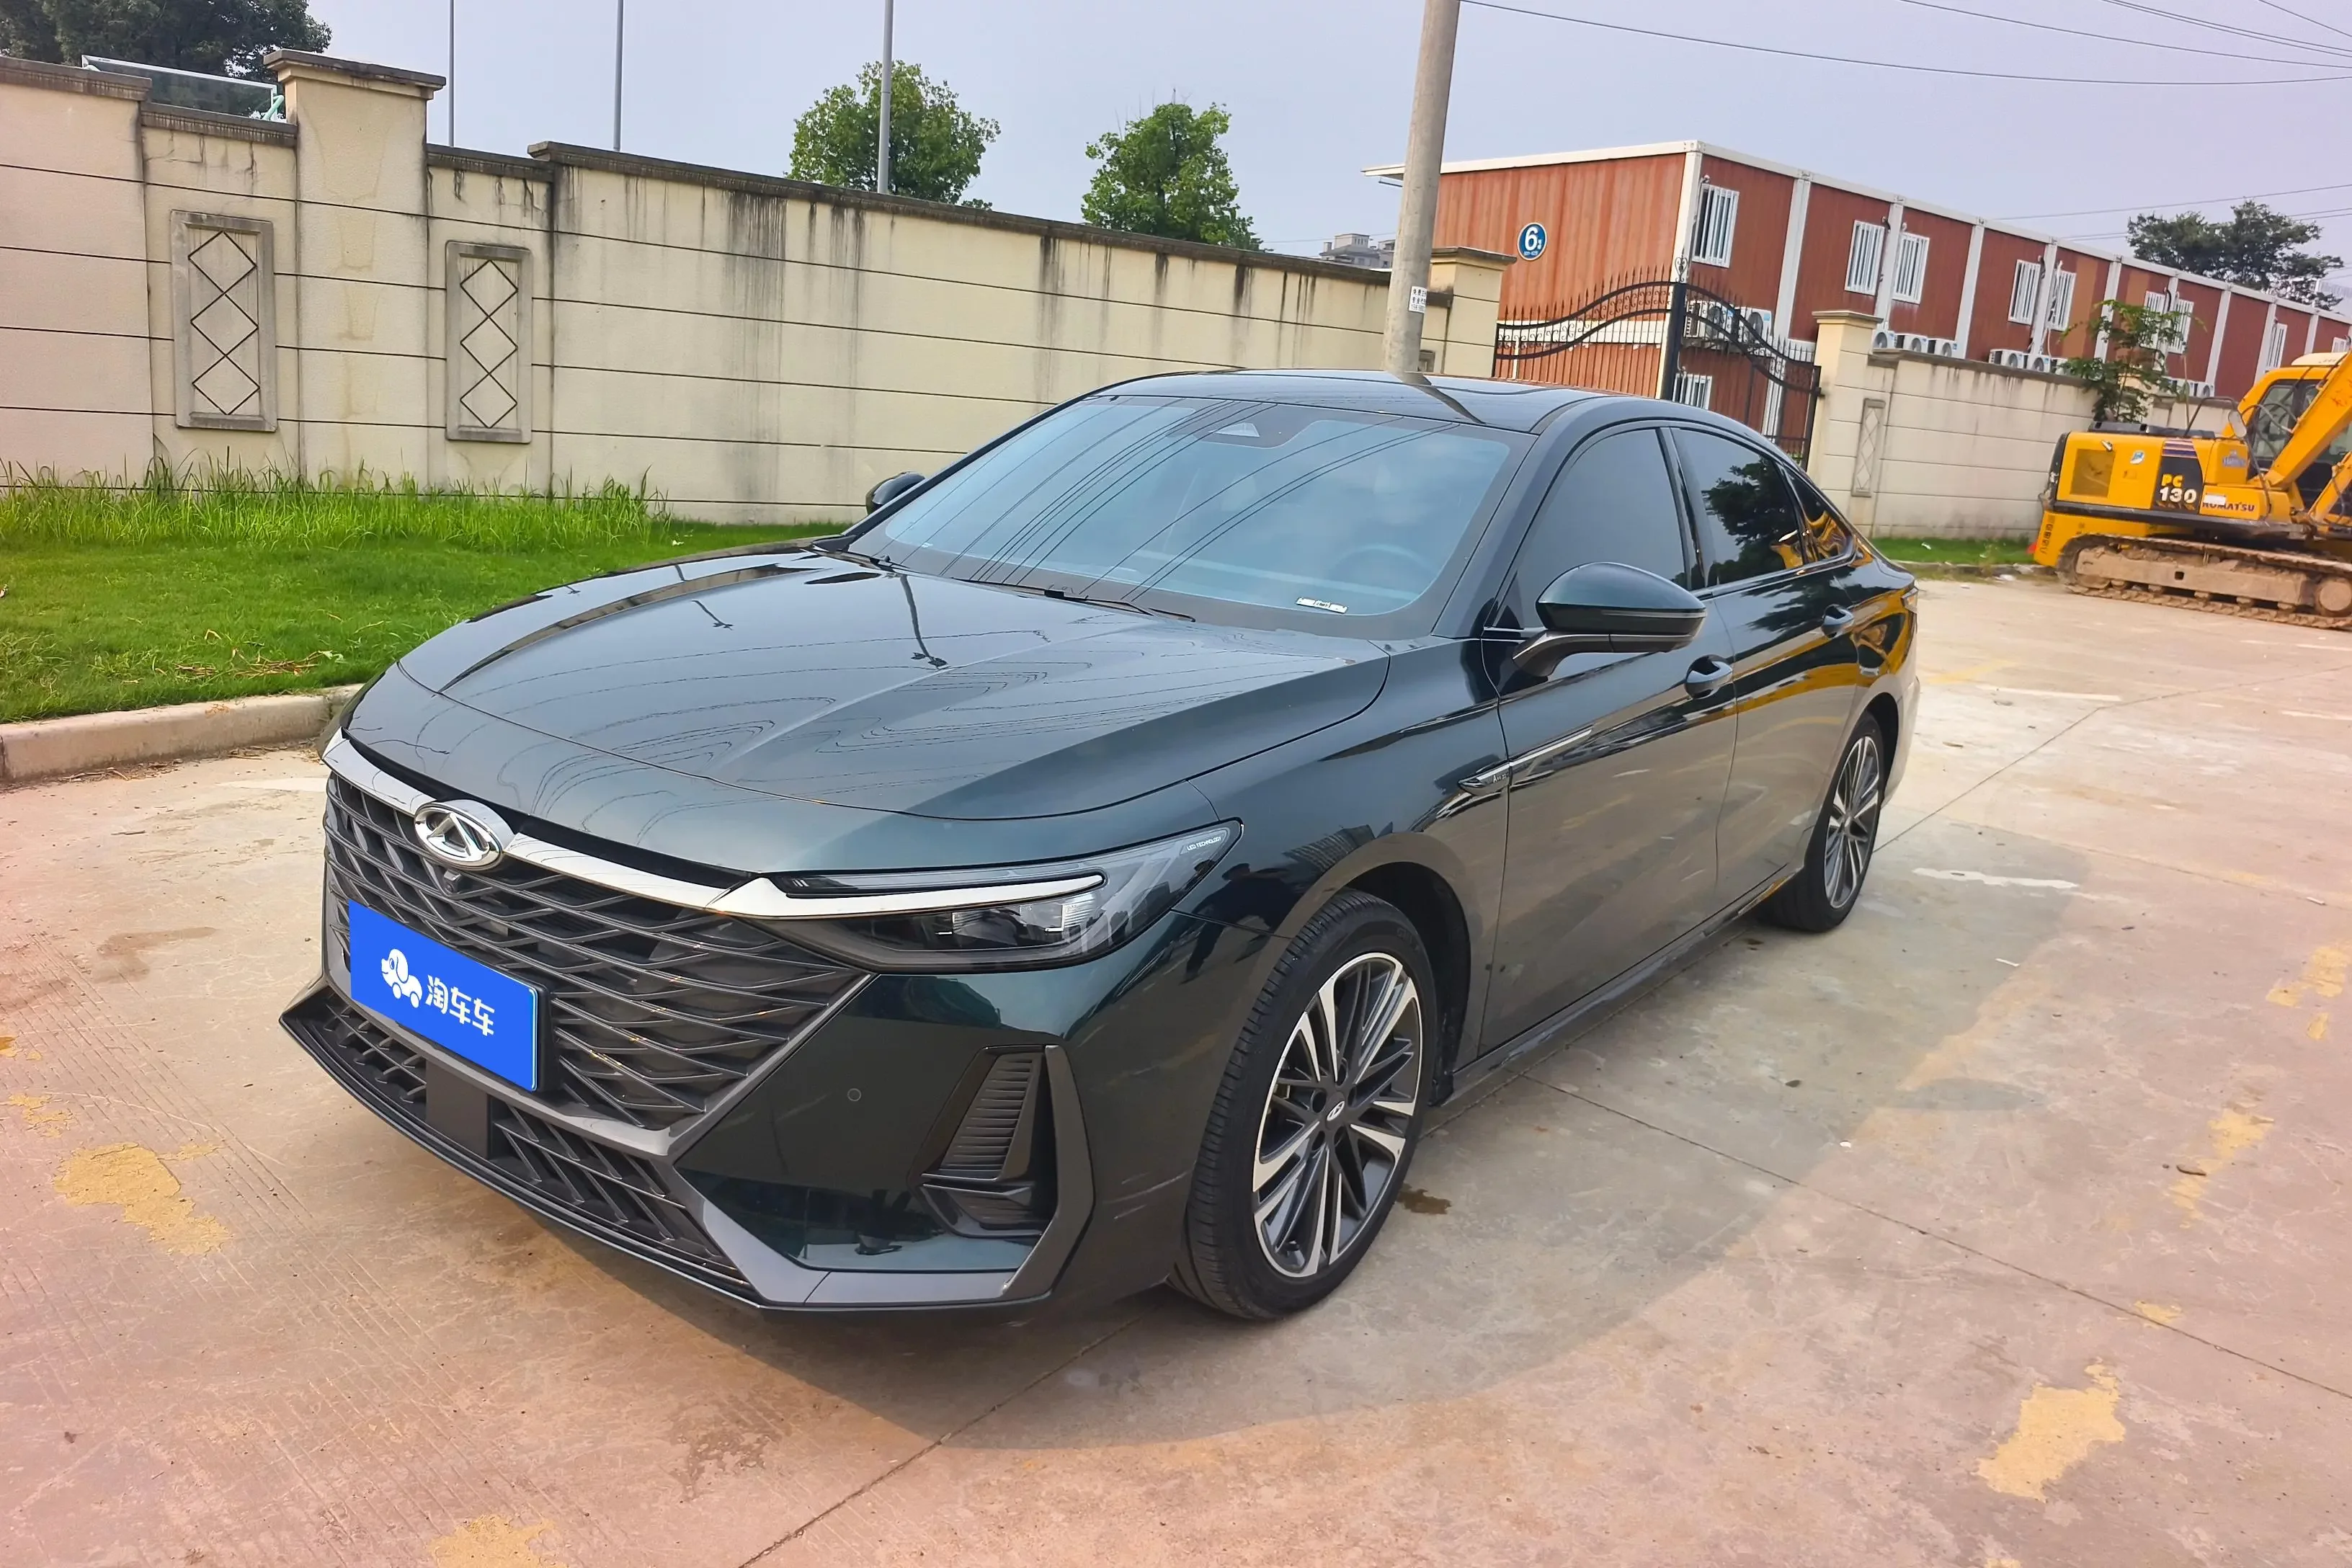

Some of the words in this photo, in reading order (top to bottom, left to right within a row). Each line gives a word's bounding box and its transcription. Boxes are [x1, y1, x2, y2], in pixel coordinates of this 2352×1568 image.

[1525, 226, 1538, 251] 6
[2162, 473, 2183, 487] PC
[2160, 486, 2197, 504] 130
